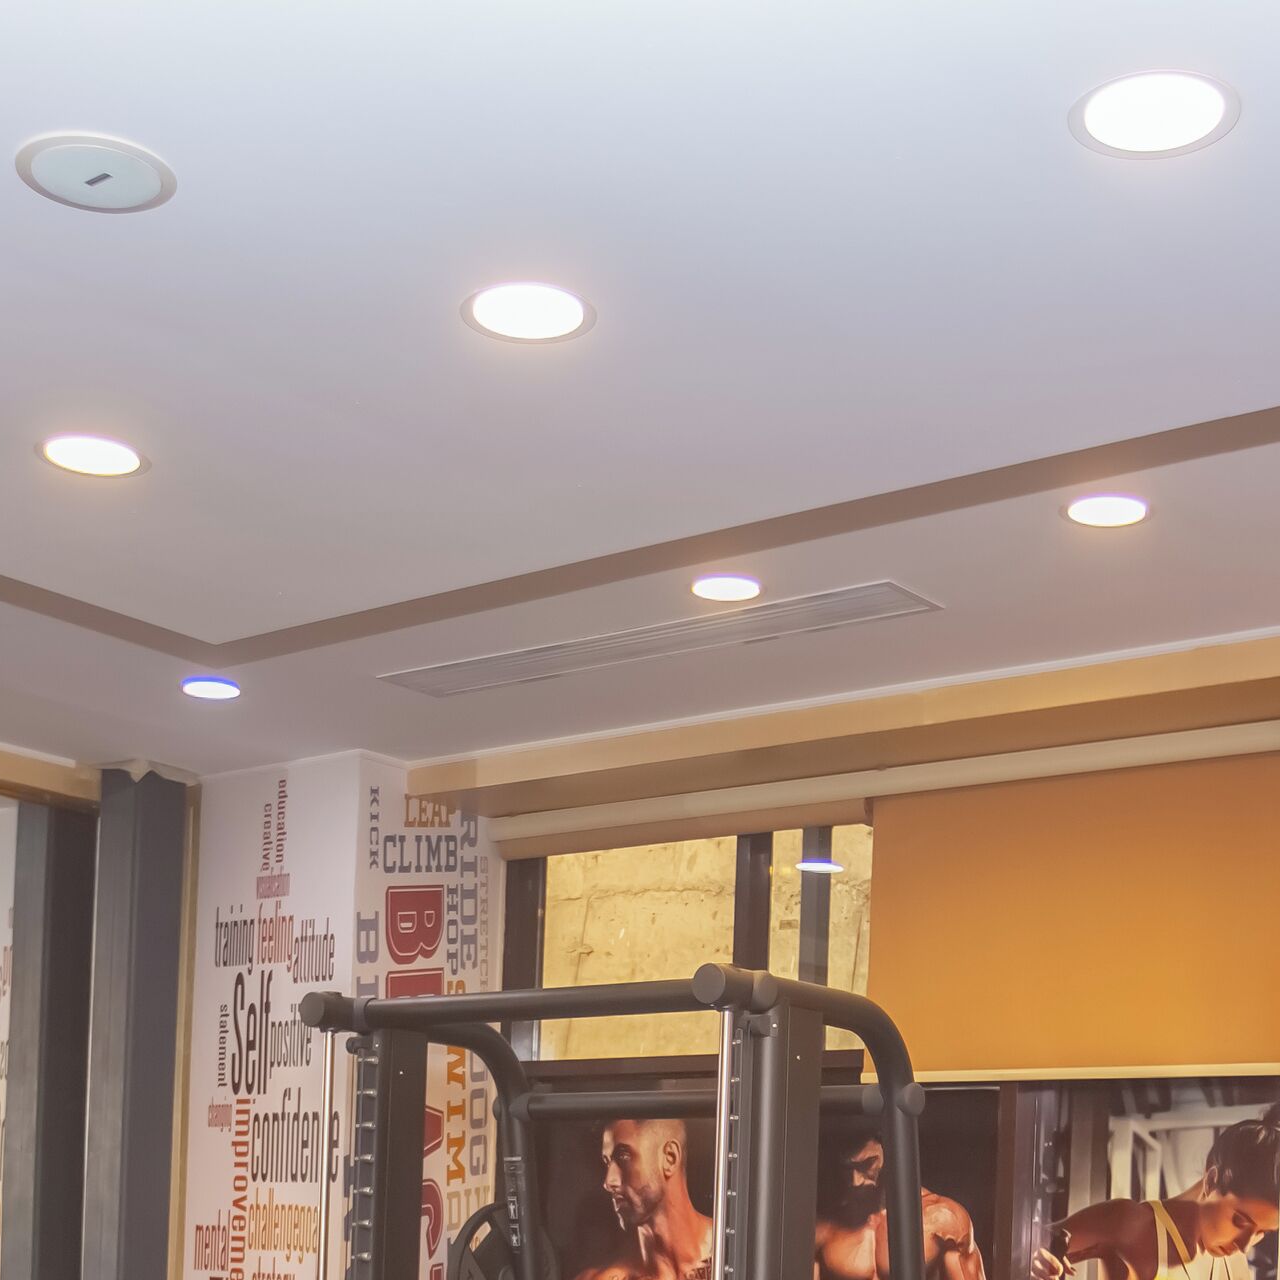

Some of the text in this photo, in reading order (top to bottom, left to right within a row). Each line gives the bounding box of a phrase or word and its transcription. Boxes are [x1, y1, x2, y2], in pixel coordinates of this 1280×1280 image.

[261, 802, 272, 871] creative
[276, 779, 288, 864] education
[369, 786, 379, 870] KICK
[404, 793, 458, 827] LEAP
[383, 834, 458, 874] CLIMB
[460, 808, 478, 971] RIDE
[214, 906, 255, 975] training
[256, 900, 294, 972] feeling
[293, 917, 335, 983] attitude
[446, 884, 458, 976] HOP
[217, 1003, 230, 1088] statement
[231, 970, 273, 1095] Self
[269, 1003, 312, 1079] positive
[251, 1087, 340, 1183] confidene
[194, 1209, 230, 1272] mental
